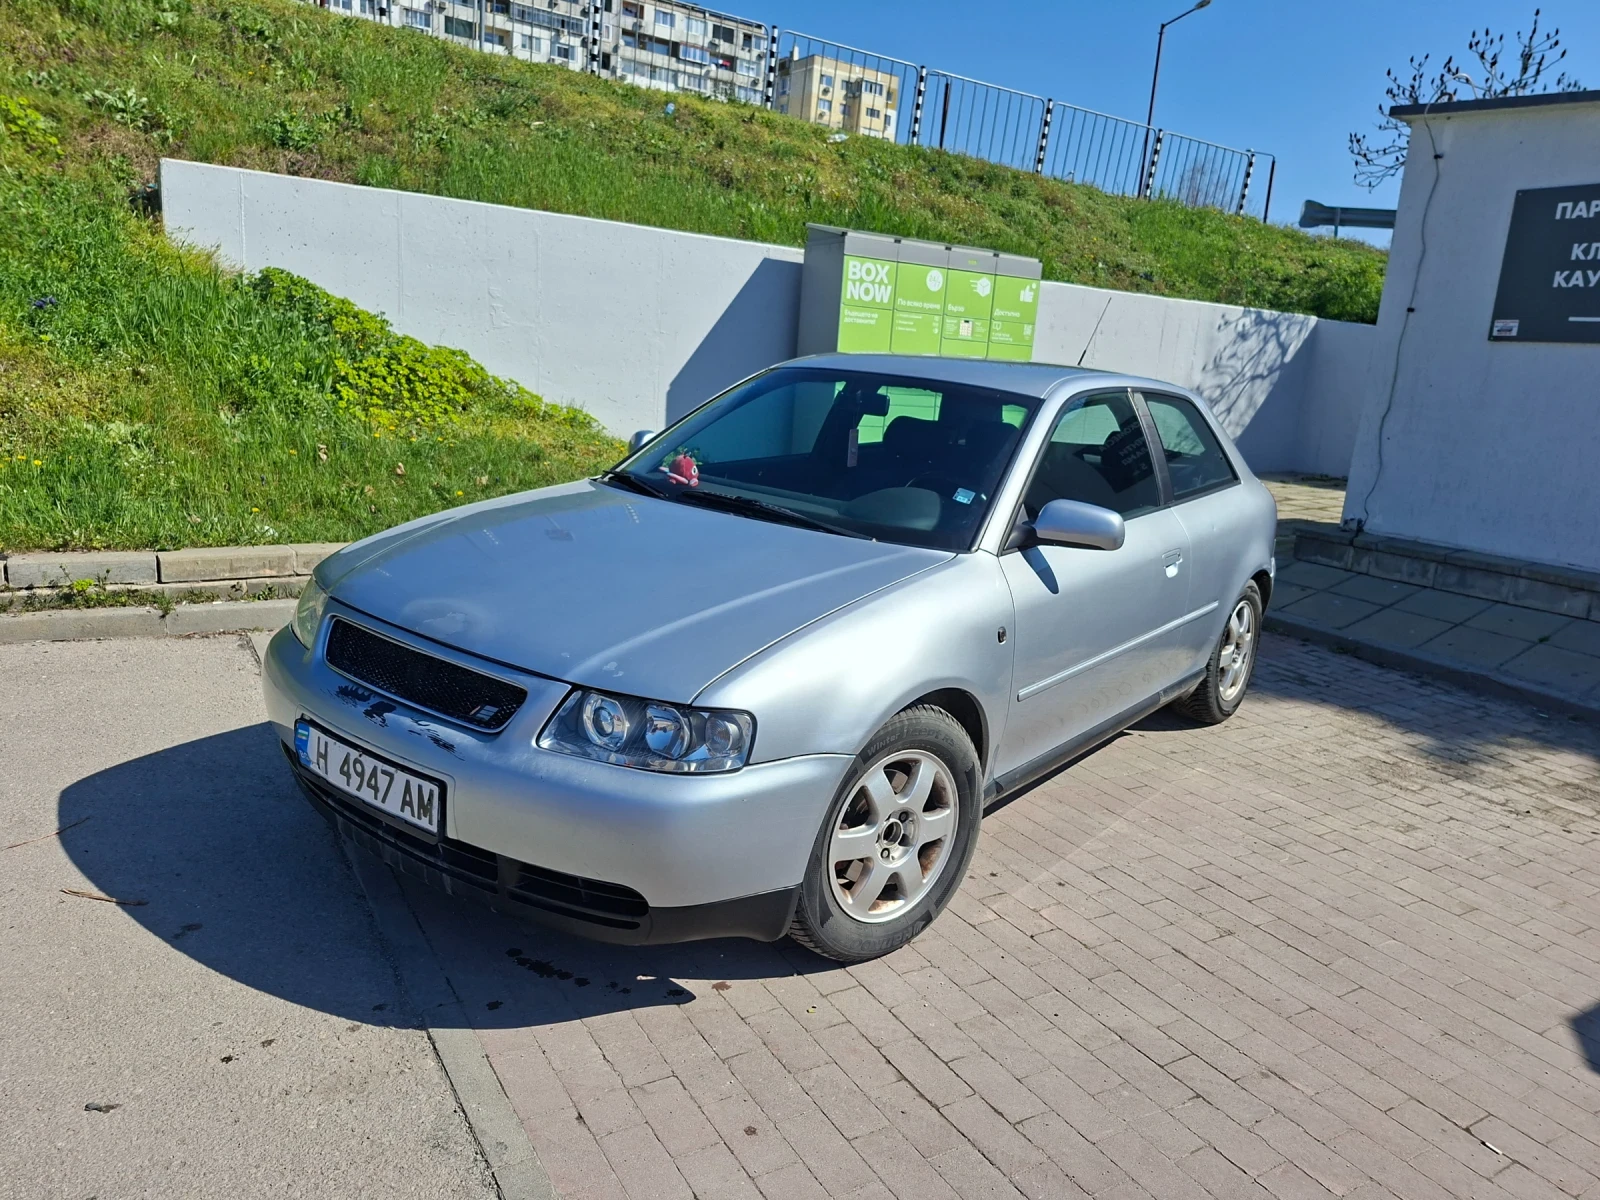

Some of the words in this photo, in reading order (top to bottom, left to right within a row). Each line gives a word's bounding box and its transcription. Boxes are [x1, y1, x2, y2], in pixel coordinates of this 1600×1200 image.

[1555, 200, 1600, 220] ПАР
[1571, 242, 1600, 261] КЛ
[848, 260, 890, 284] BOX
[1552, 270, 1600, 288] КАУ
[846, 280, 892, 304] NOW
[315, 736, 329, 776] H
[339, 751, 395, 805] 4947
[400, 779, 435, 826] AM
